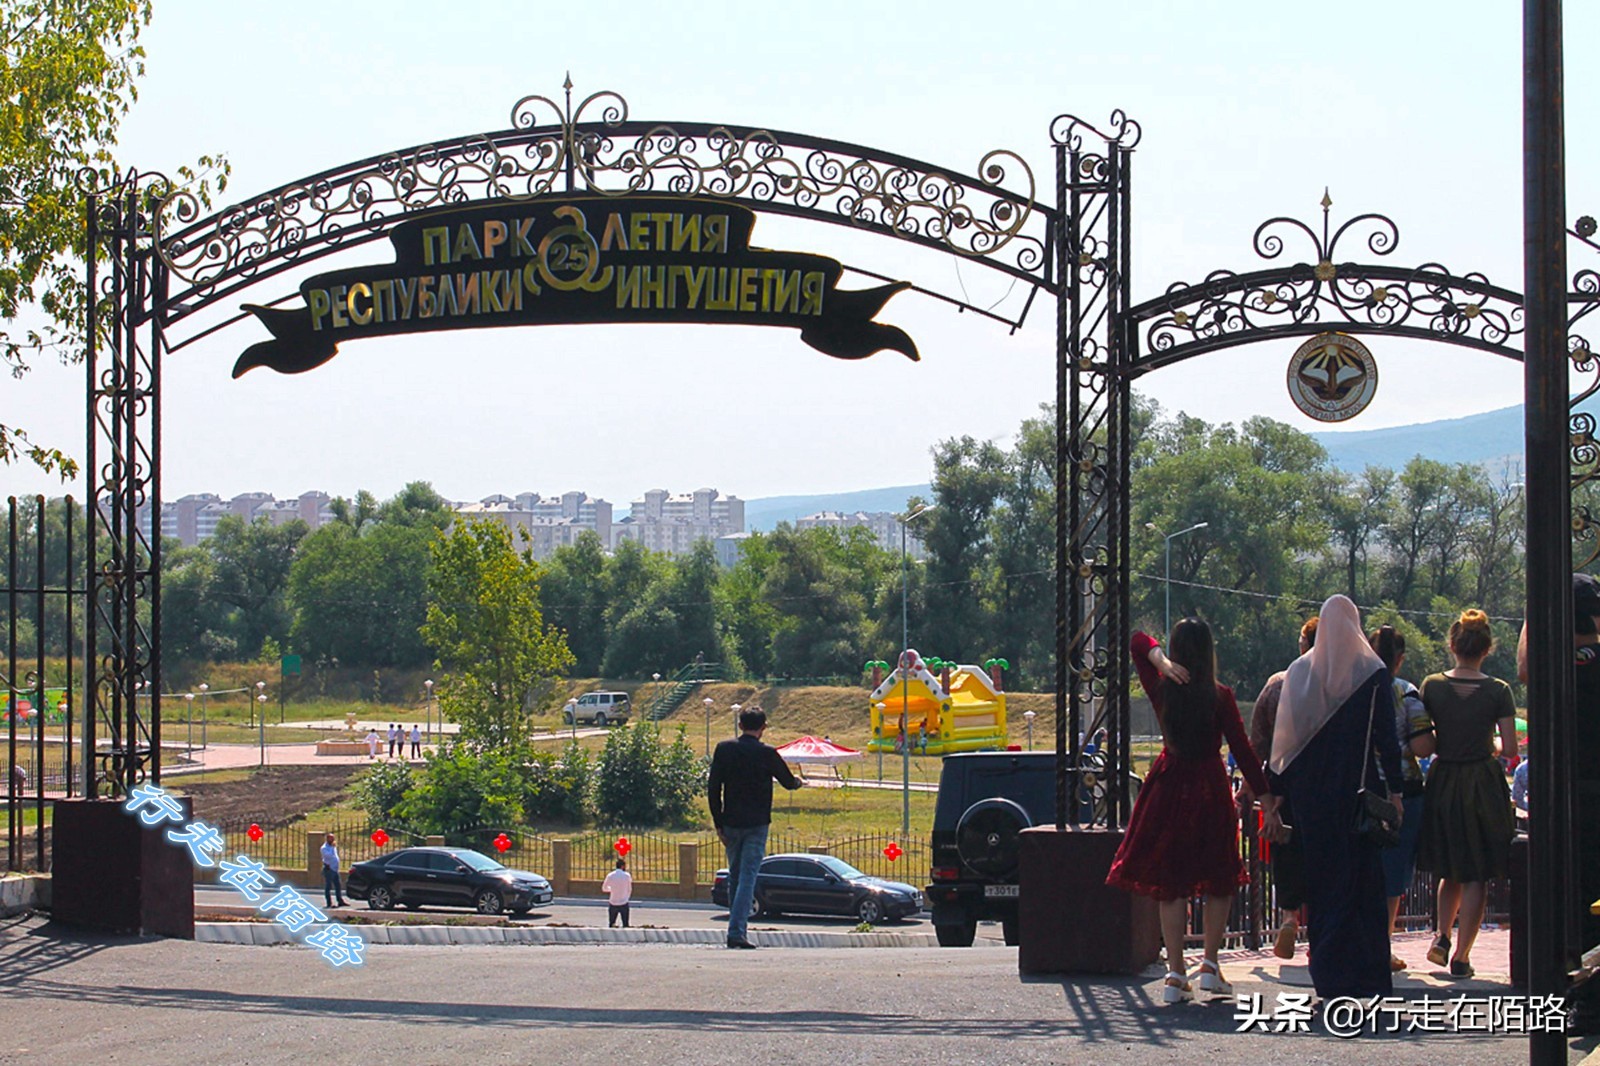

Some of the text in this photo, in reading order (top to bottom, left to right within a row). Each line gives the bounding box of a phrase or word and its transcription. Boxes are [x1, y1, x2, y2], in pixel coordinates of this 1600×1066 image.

[422, 212, 729, 271] ПАРК 25 ЛЕТИЯ
[309, 265, 826, 331] РЕСПУБЛИКИ ИНГУШЕТИЯ
